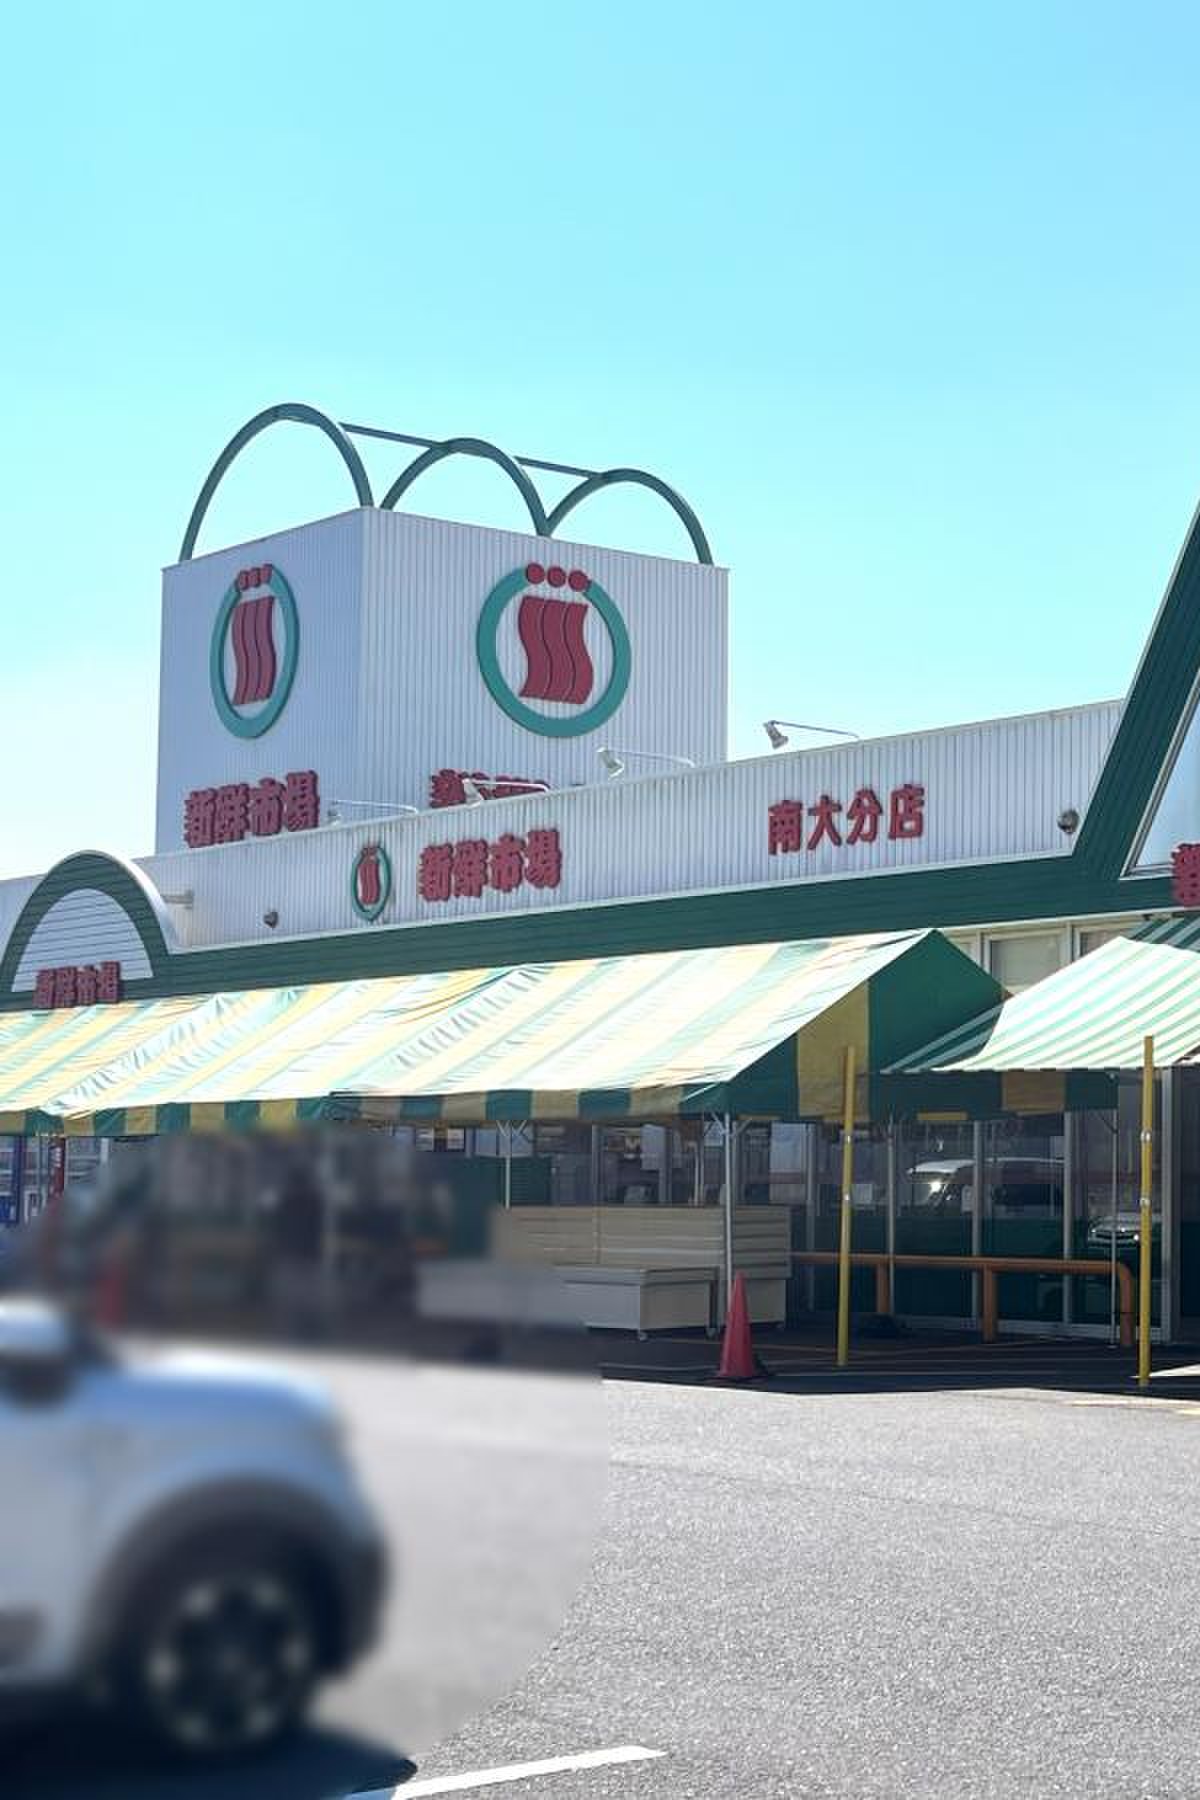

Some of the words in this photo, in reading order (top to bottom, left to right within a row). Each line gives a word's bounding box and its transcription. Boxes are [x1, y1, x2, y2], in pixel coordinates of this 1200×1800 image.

[184, 770, 320, 848] 新鮮市場
[767, 783, 925, 856] 南大分店
[418, 829, 562, 903] 新鮮市場
